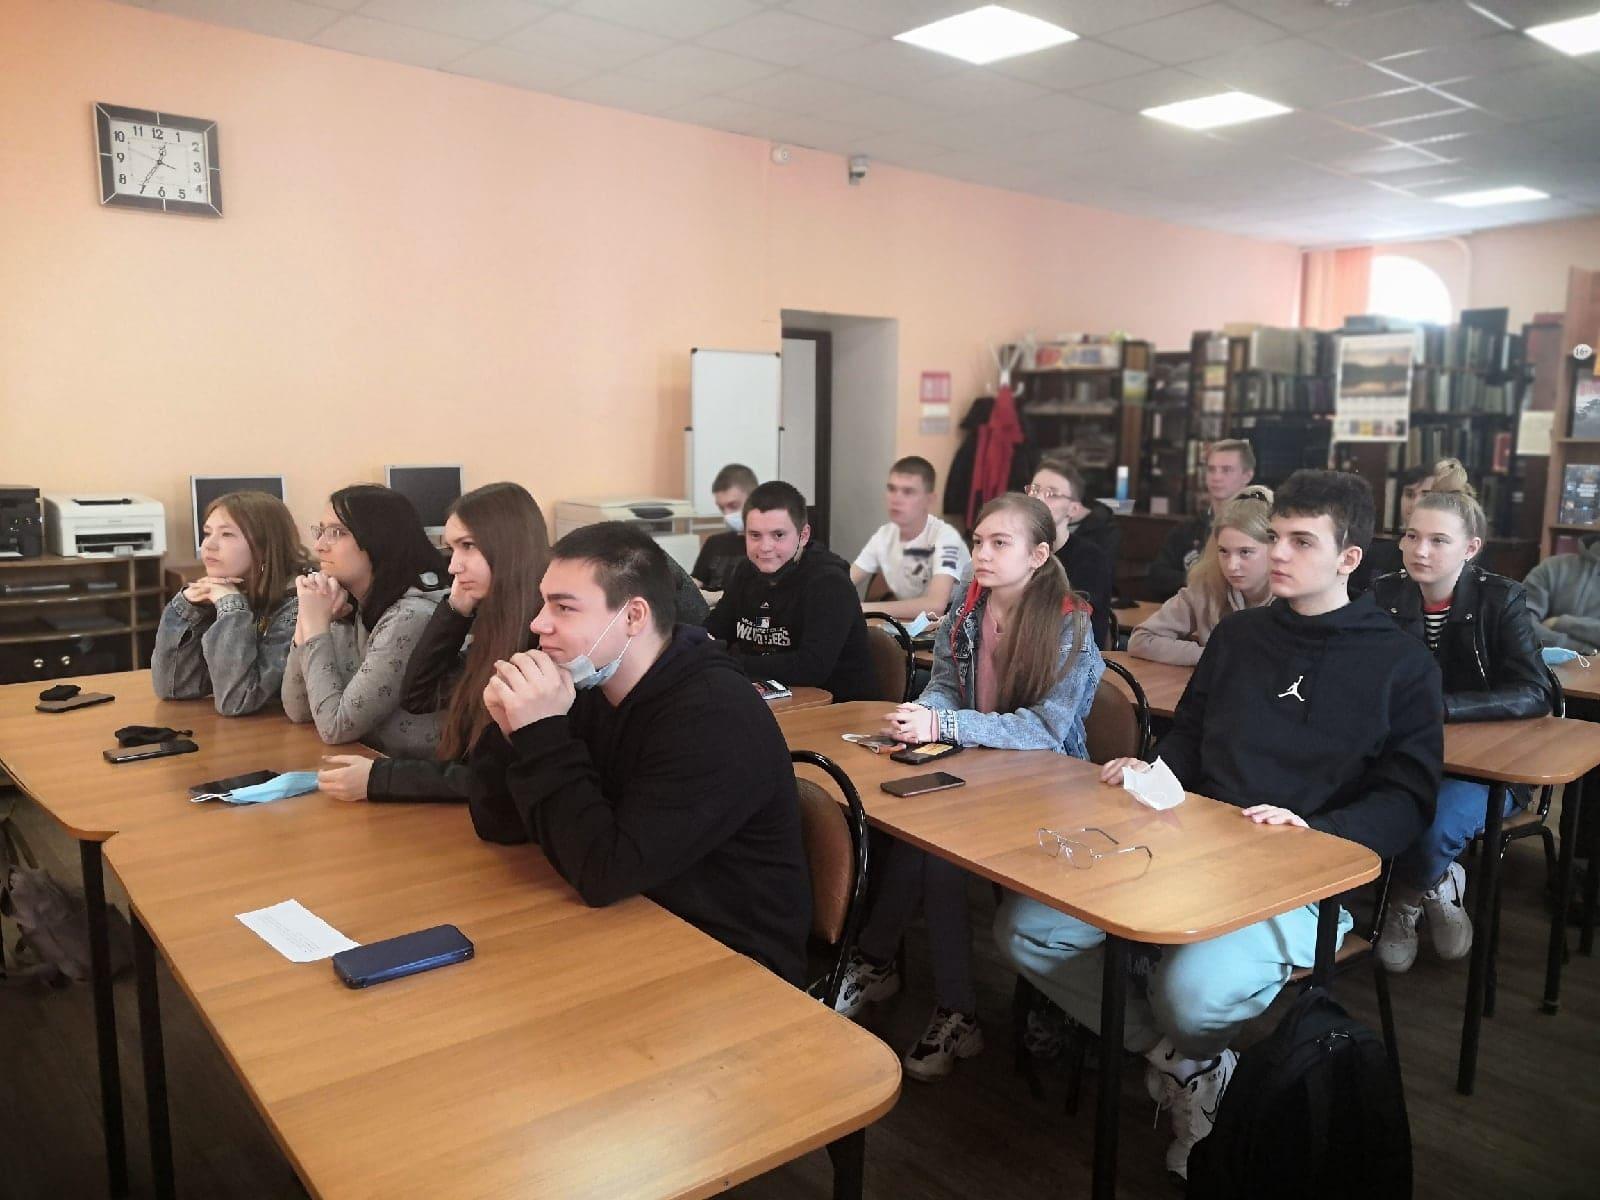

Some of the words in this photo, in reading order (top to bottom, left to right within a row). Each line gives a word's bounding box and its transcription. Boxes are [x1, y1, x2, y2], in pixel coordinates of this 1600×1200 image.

[114, 130, 125, 143] 10
[133, 126, 143, 137] 11
[152, 128, 164, 140] 12
[175, 131, 181, 143] 1
[191, 141, 200, 152] 2
[116, 152, 125, 163] 9
[193, 161, 201, 173] 3
[119, 174, 127, 184] 8
[139, 184, 147, 194] 7
[158, 187, 166, 197] 6
[178, 188, 186, 199] 5
[195, 185, 202, 194] 4
